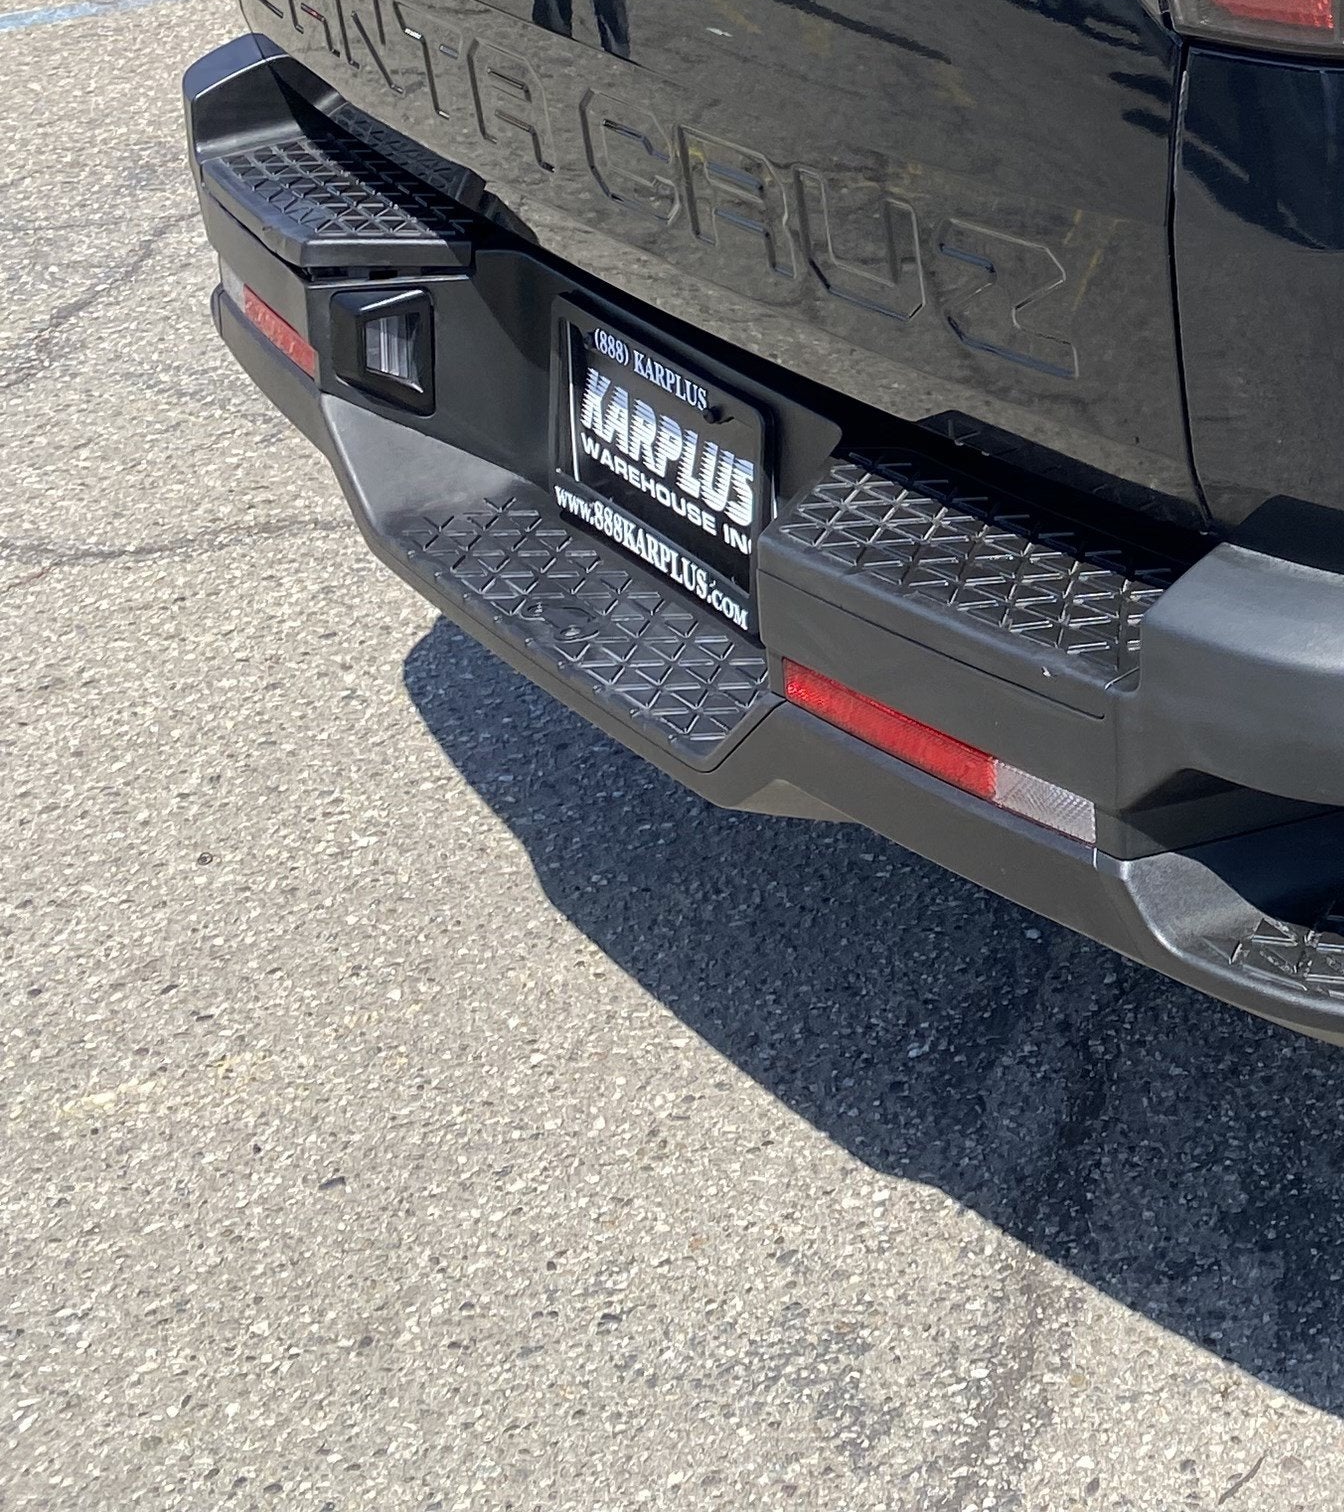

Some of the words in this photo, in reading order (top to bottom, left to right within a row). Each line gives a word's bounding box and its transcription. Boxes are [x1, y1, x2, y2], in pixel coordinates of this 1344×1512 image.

[594, 328, 629, 367] (888)
[633, 349, 709, 411] KARPLUS
[580, 367, 754, 527] KARPLUS
[581, 432, 717, 536] WAREHOUSE
